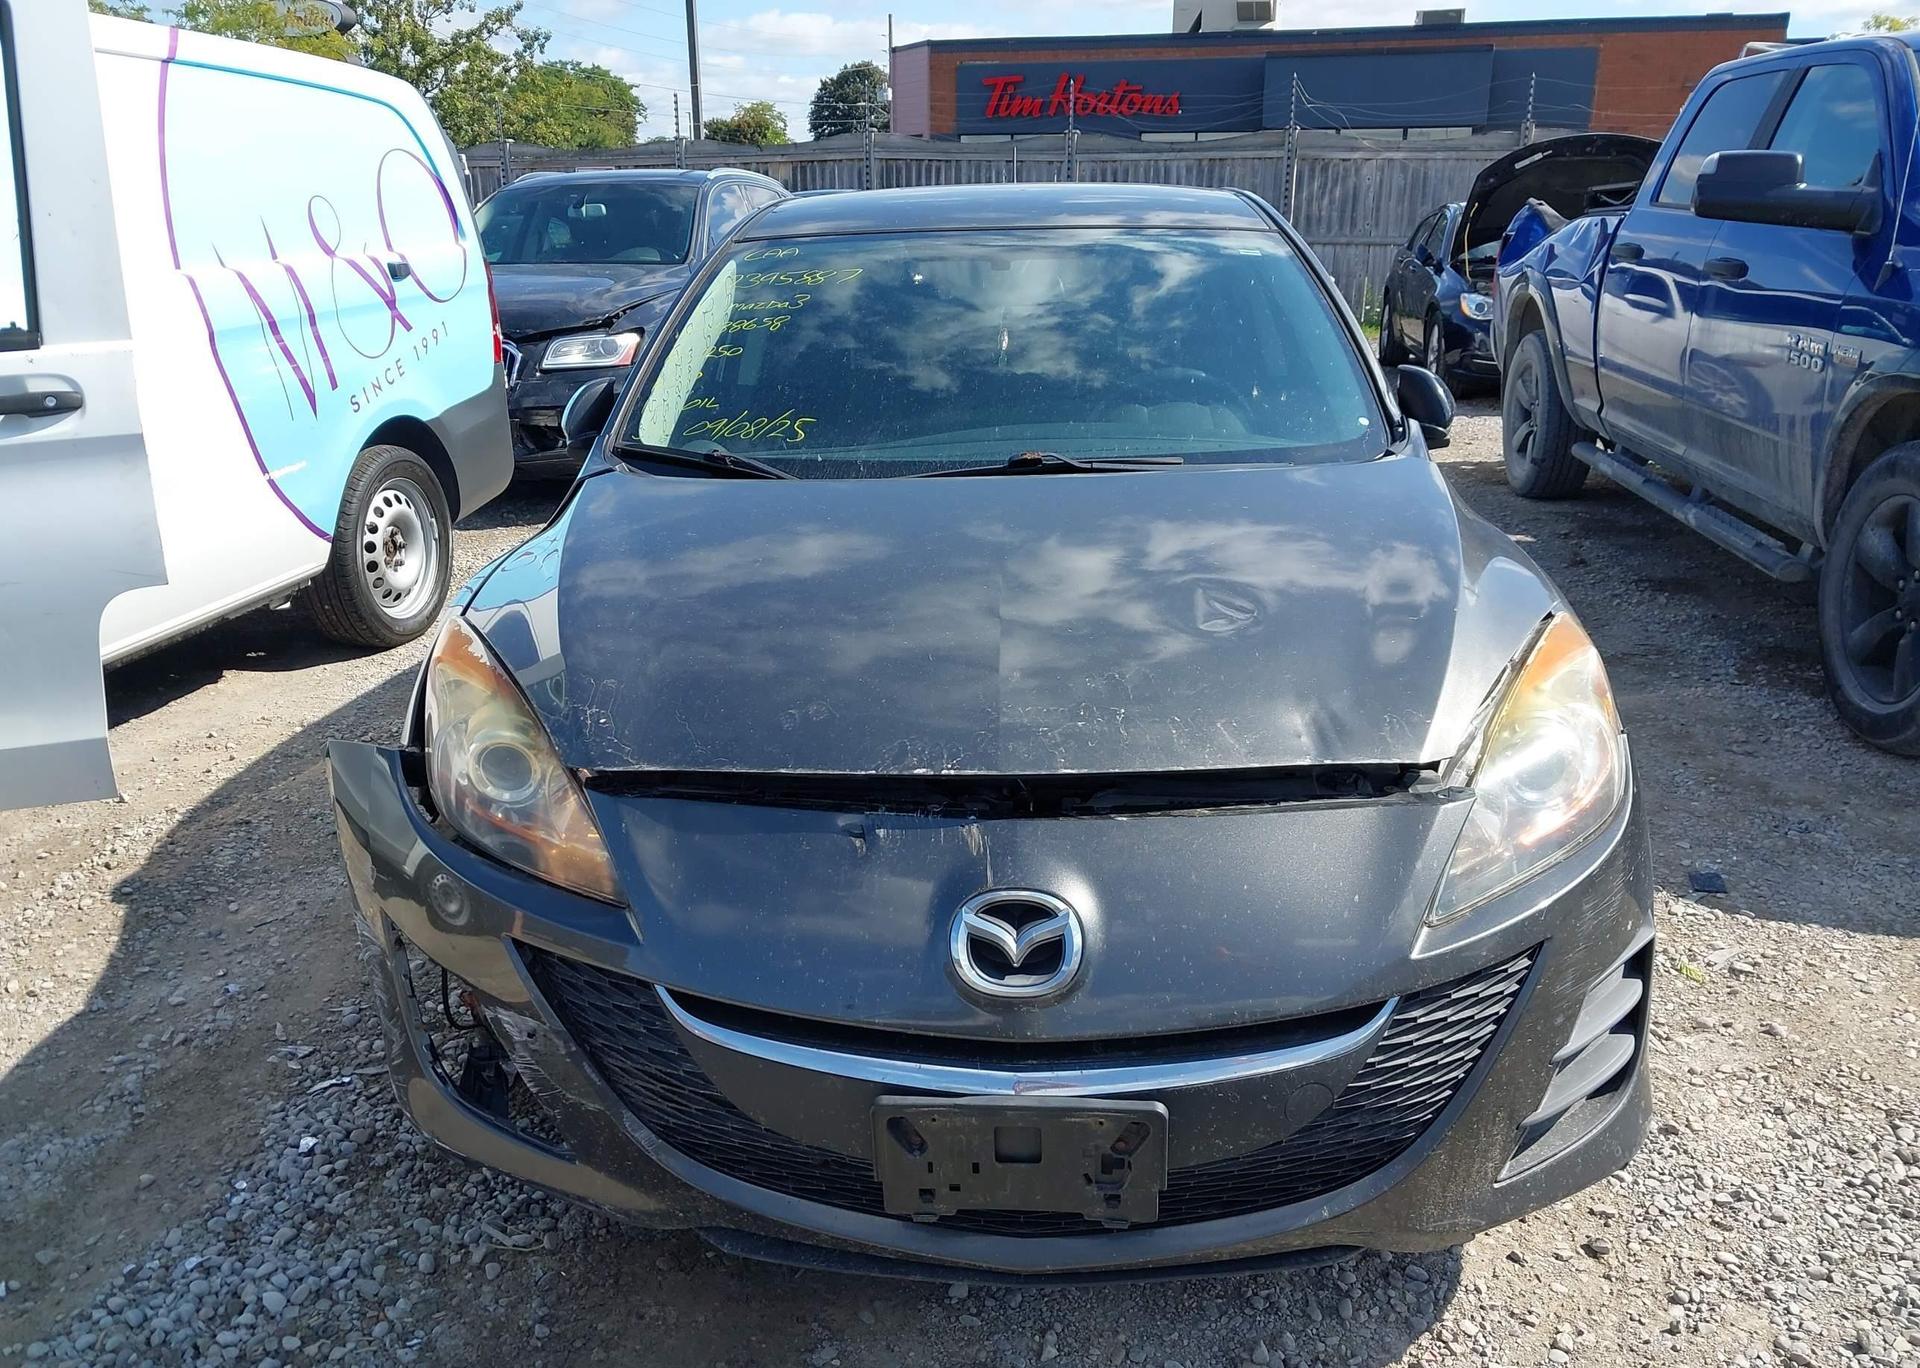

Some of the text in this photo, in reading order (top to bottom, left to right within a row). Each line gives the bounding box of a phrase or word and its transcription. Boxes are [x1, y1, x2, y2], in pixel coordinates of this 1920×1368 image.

[982, 72, 1180, 119] Tim Hortons
[1786, 332, 1828, 358] RAM
[350, 320, 449, 413] SINCE 1991
[682, 397, 719, 411] OIL
[682, 409, 817, 442] 09/08/25
